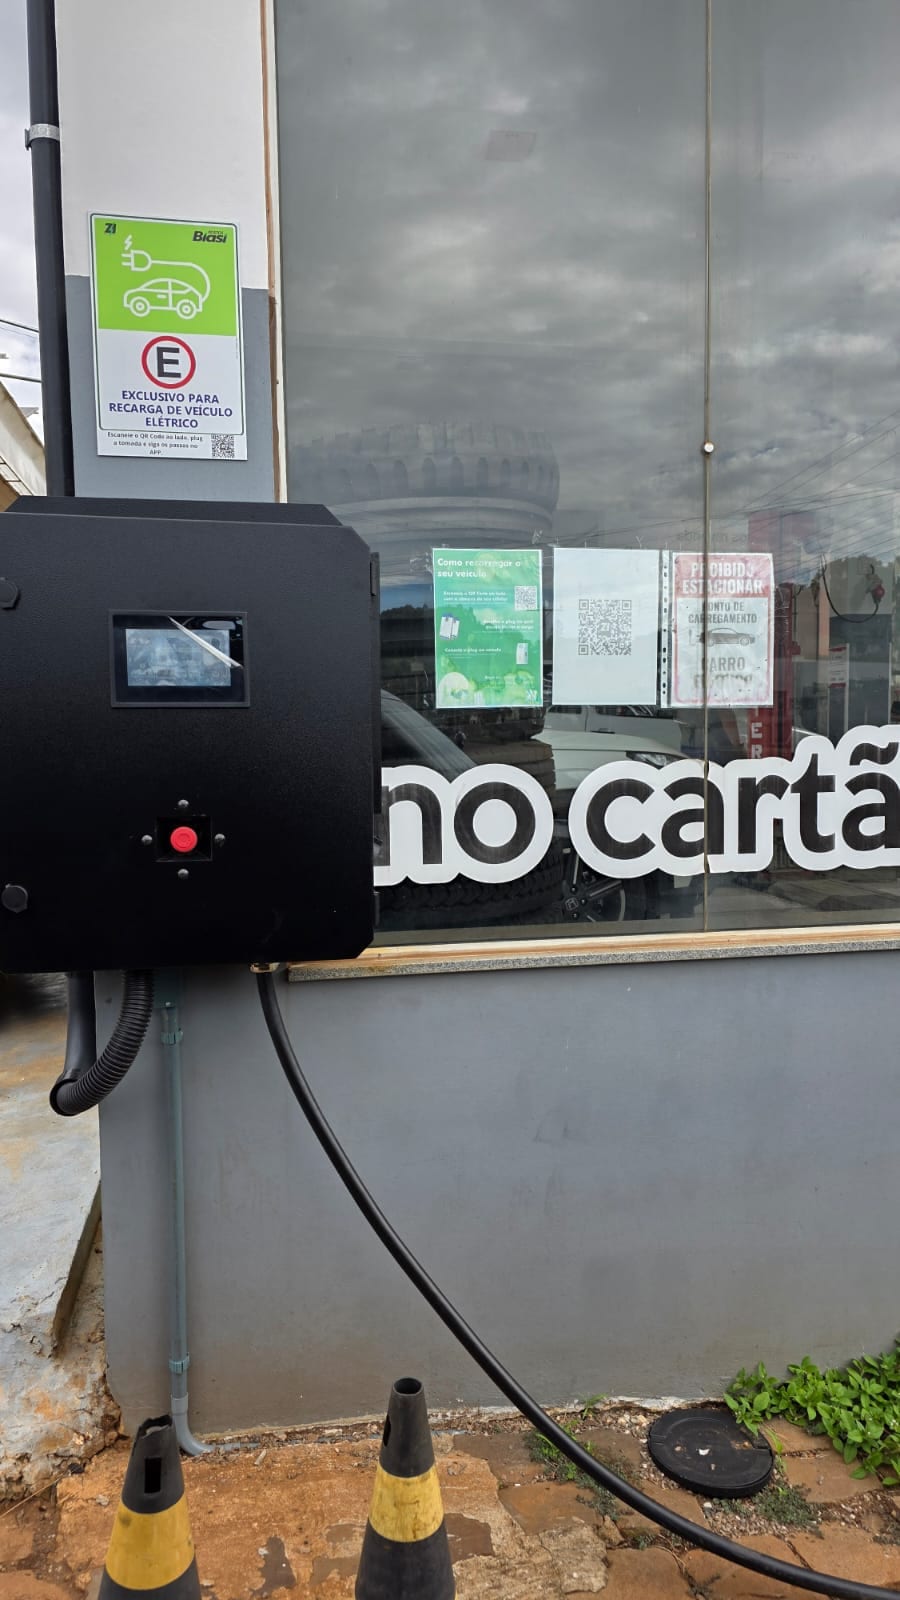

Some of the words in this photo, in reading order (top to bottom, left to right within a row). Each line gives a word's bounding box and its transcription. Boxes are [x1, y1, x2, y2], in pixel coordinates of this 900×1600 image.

[156, 346, 182, 378] E
[122, 390, 185, 402] EXCLUSIVO
[188, 394, 220, 404] PARA
[109, 402, 164, 414] RECARGA
[167, 406, 182, 415] DE
[185, 404, 233, 418] VEÍCULO
[146, 416, 198, 428] ELÉTRICO
[438, 558, 462, 566] Como
[682, 578, 763, 594] ESTACIONAR
[734, 601, 744, 612] DE
[374, 782, 536, 866] no
